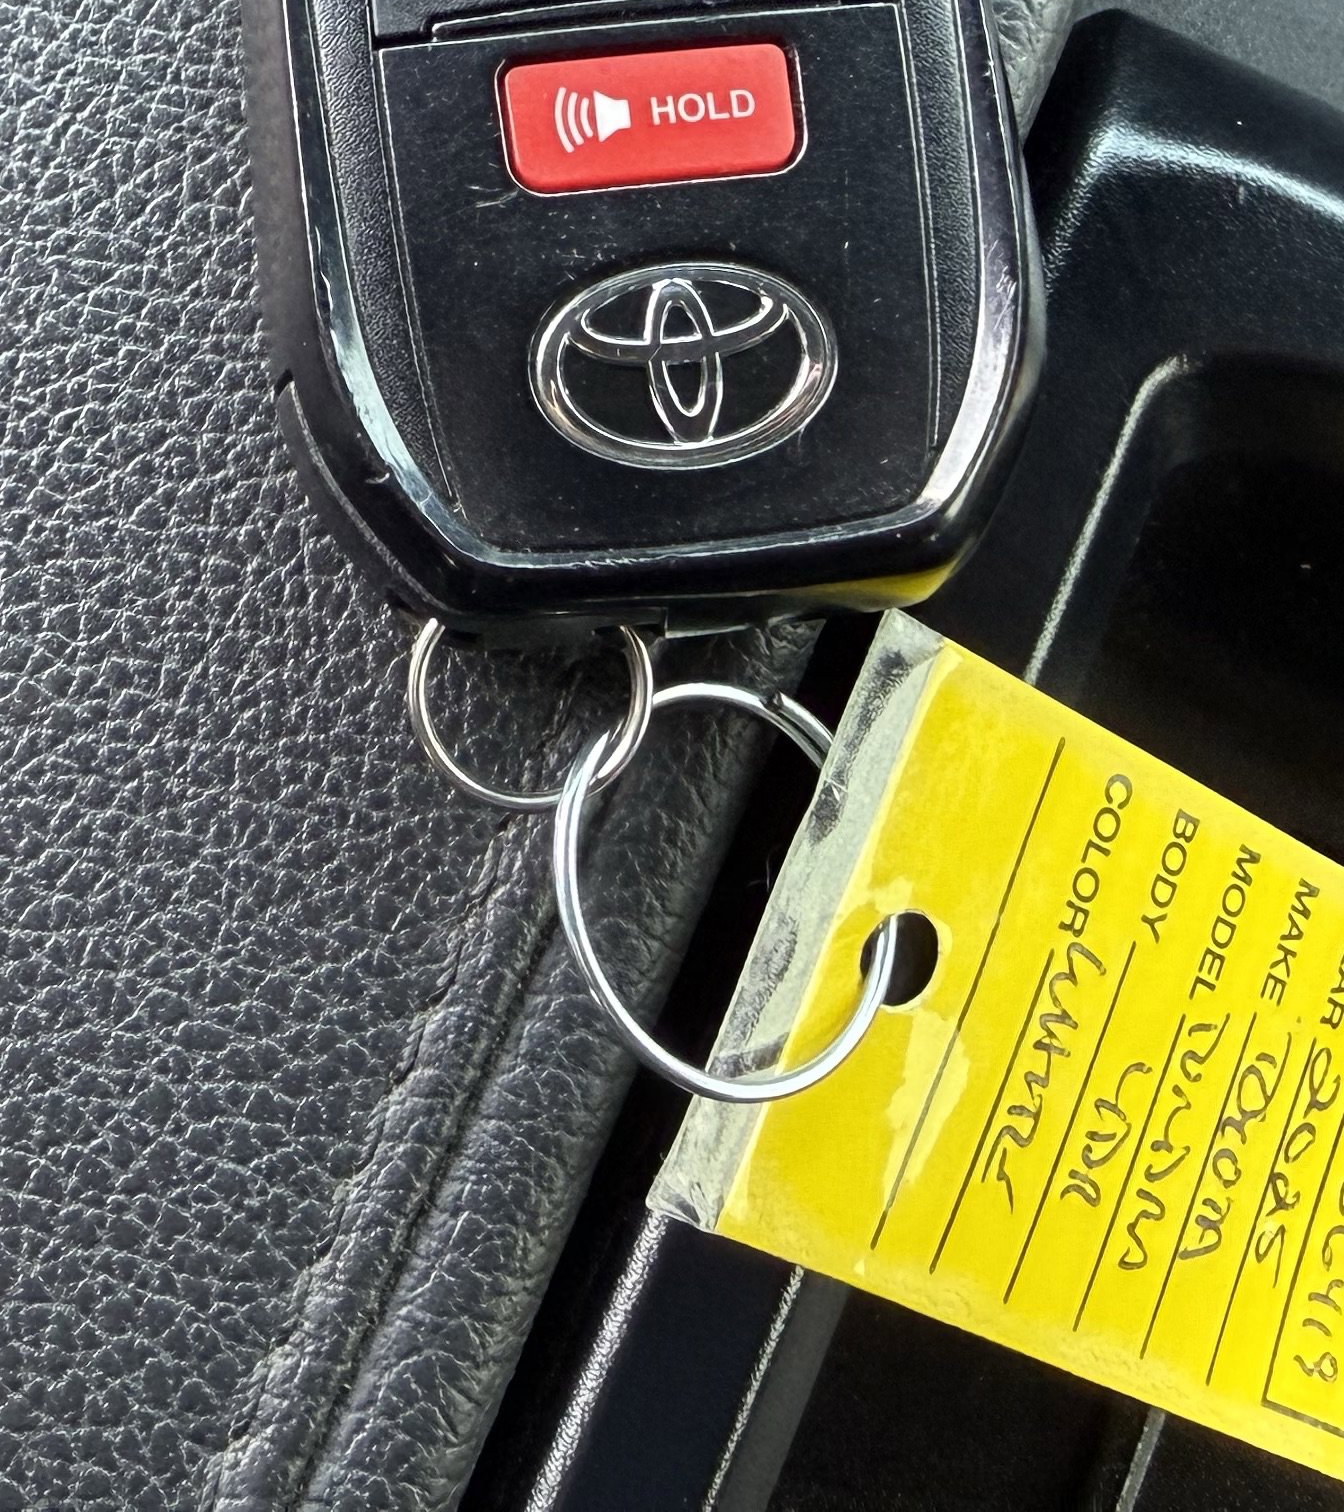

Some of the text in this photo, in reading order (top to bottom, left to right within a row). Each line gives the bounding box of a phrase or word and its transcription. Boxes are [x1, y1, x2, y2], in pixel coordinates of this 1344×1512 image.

[650, 89, 756, 125] HOLD
[1058, 773, 1133, 938] COLOR
[1141, 808, 1200, 944] BODY
[1189, 843, 1261, 1000] MODEL
[1178, 877, 1320, 1260] MAKE TOYOTA
[1255, 1047, 1341, 1289] 2025
